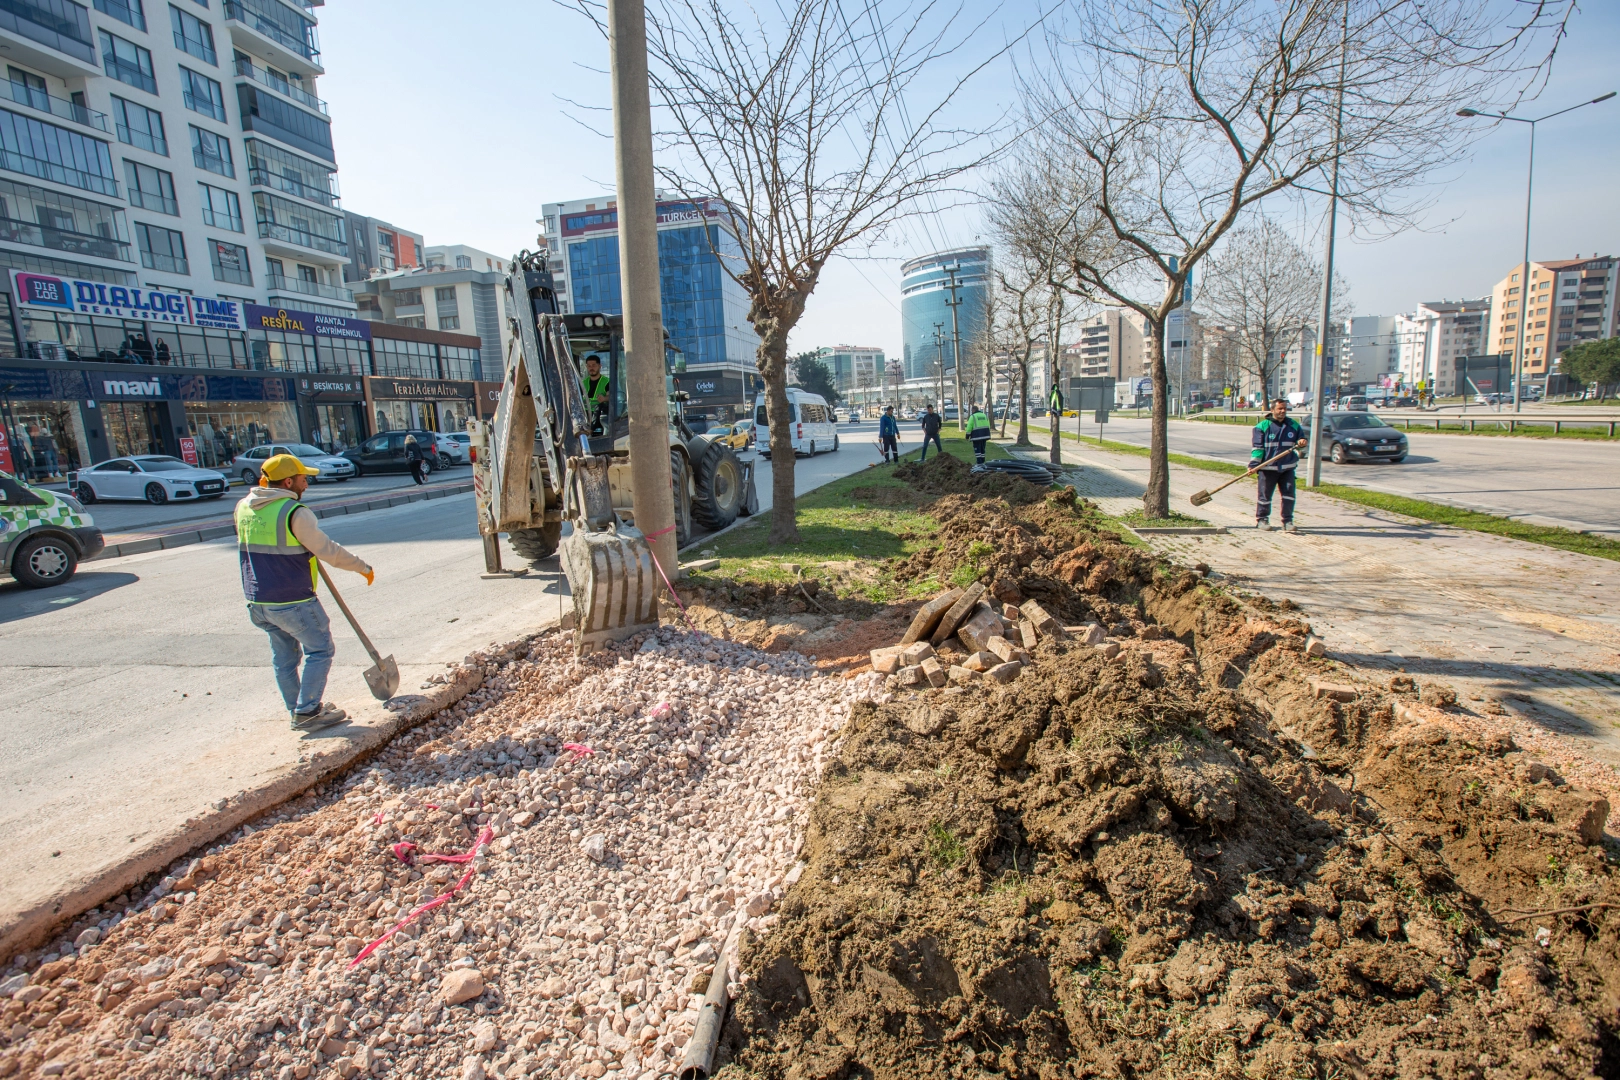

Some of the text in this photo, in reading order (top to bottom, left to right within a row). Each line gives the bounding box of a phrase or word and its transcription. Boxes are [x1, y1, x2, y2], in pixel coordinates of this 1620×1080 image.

[33, 281, 57, 292] DIA
[35, 290, 58, 300] LOG
[74, 281, 184, 315] DIALOG
[80, 304, 188, 323] REAL ESTATE
[192, 297, 239, 317] TIME
[314, 315, 346, 326] AVANTAJ
[315, 325, 363, 338] GAYRİMENKUL
[103, 376, 162, 396] mavi
[313, 381, 344, 391] BEŞİKTAŞ
